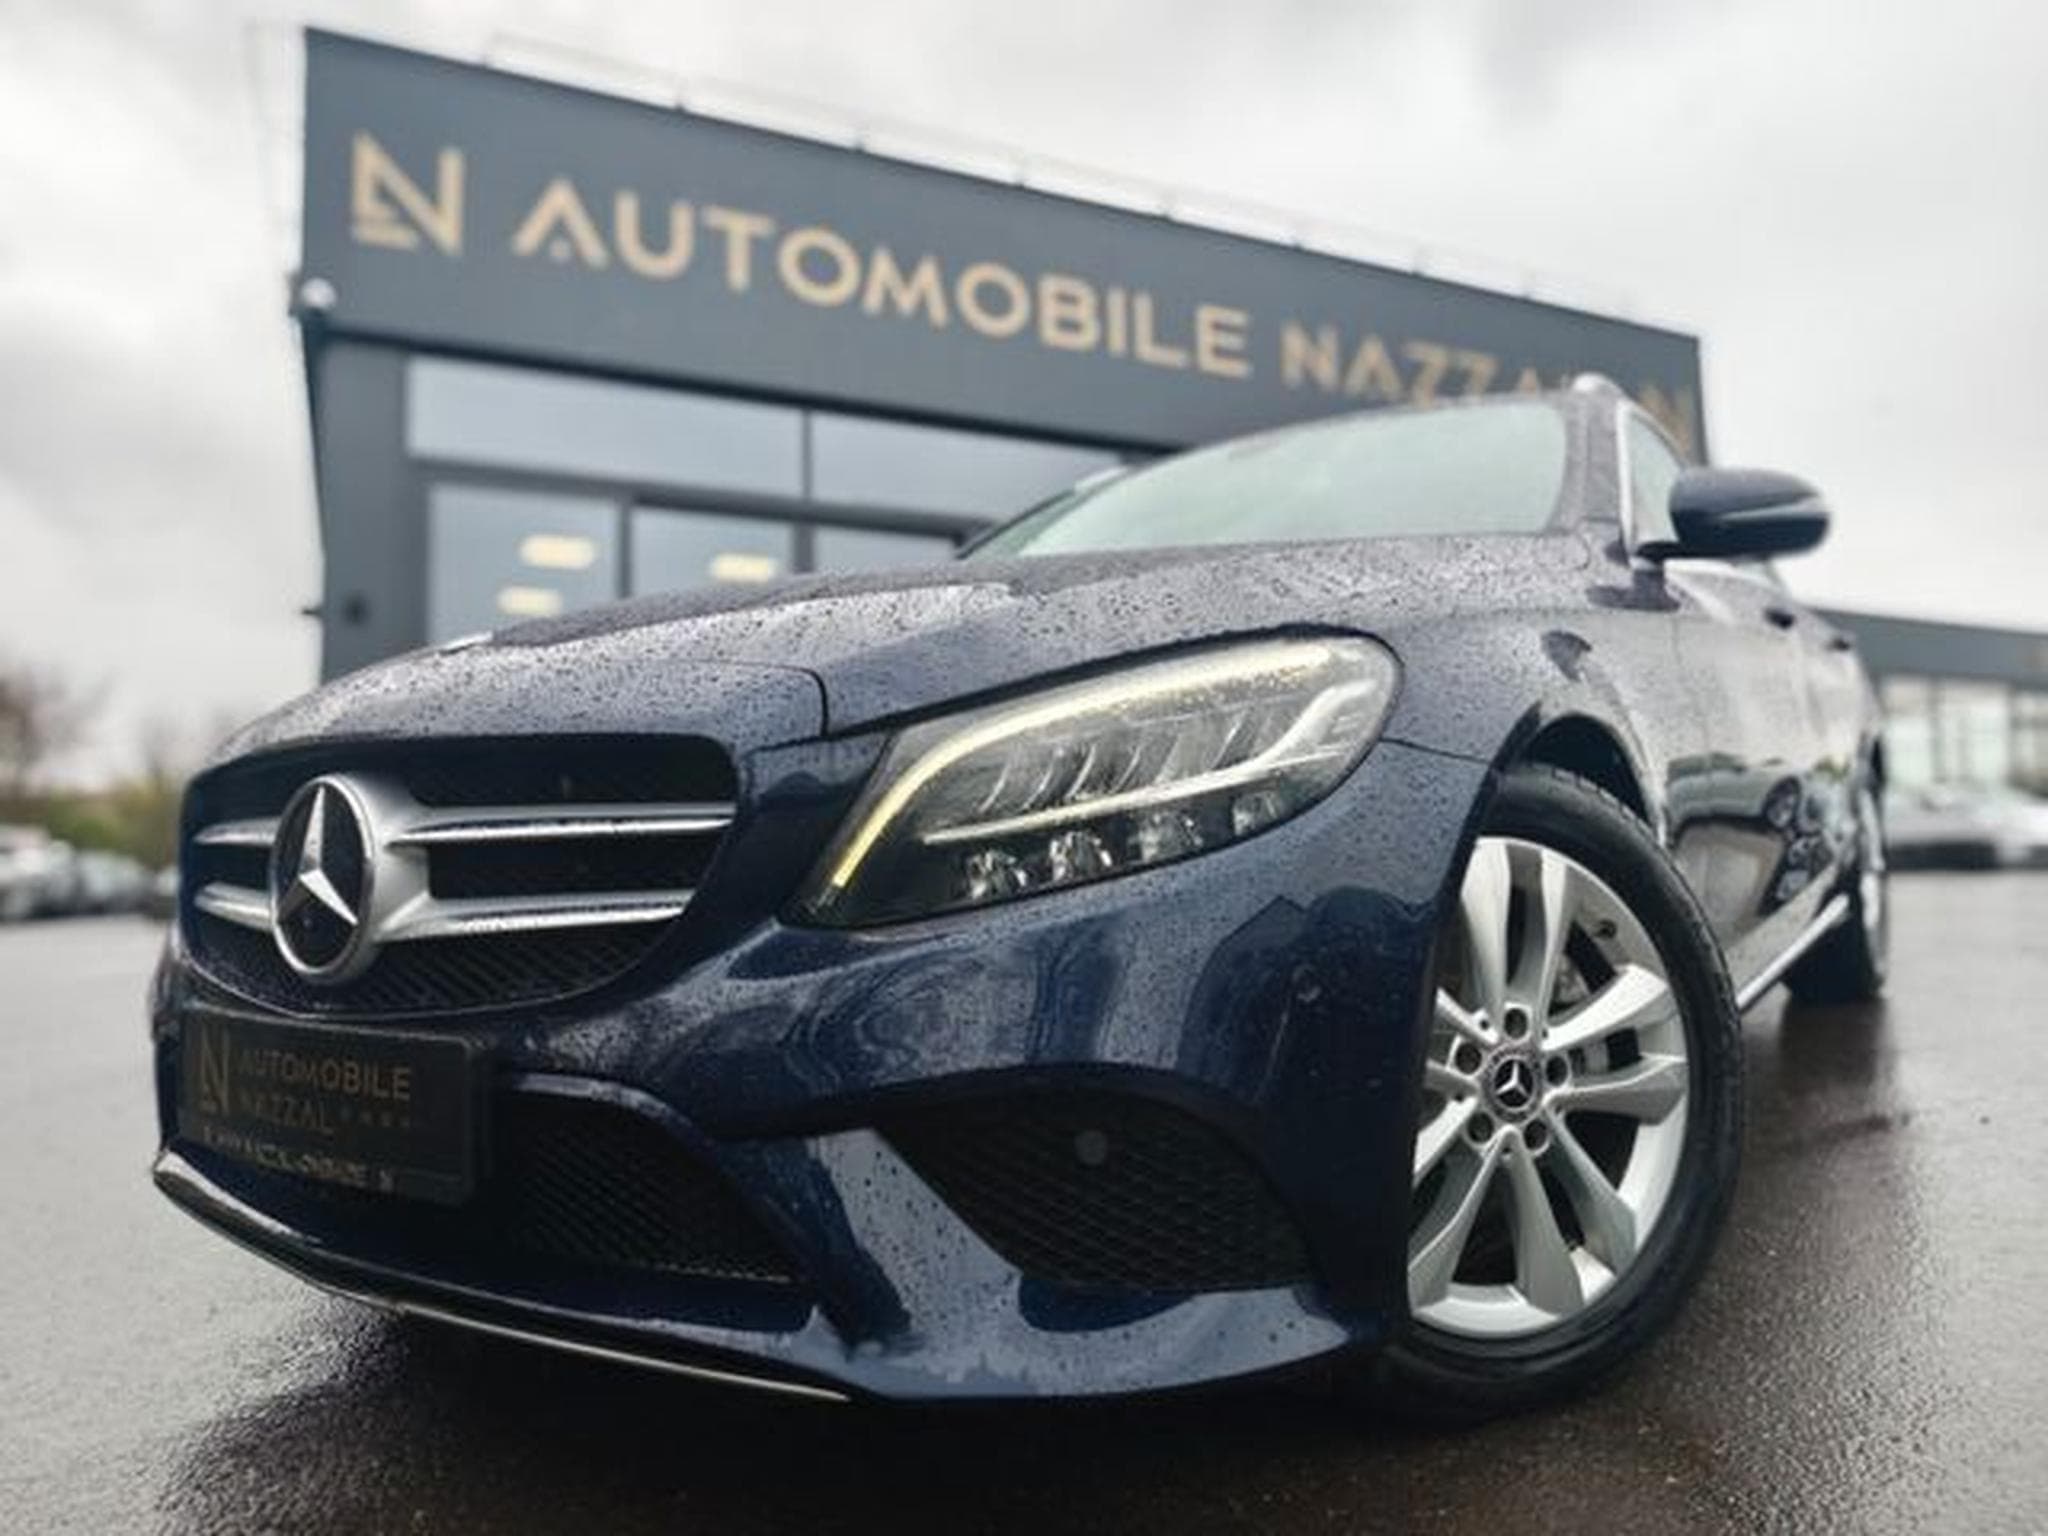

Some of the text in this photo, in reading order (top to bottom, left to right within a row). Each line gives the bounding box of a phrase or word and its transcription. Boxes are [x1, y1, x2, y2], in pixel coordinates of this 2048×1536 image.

[511, 178, 1254, 381] AUTOMOBILE
[1279, 320, 1570, 408] NAZZ
[235, 1047, 411, 1101] AUTOMOBILE
